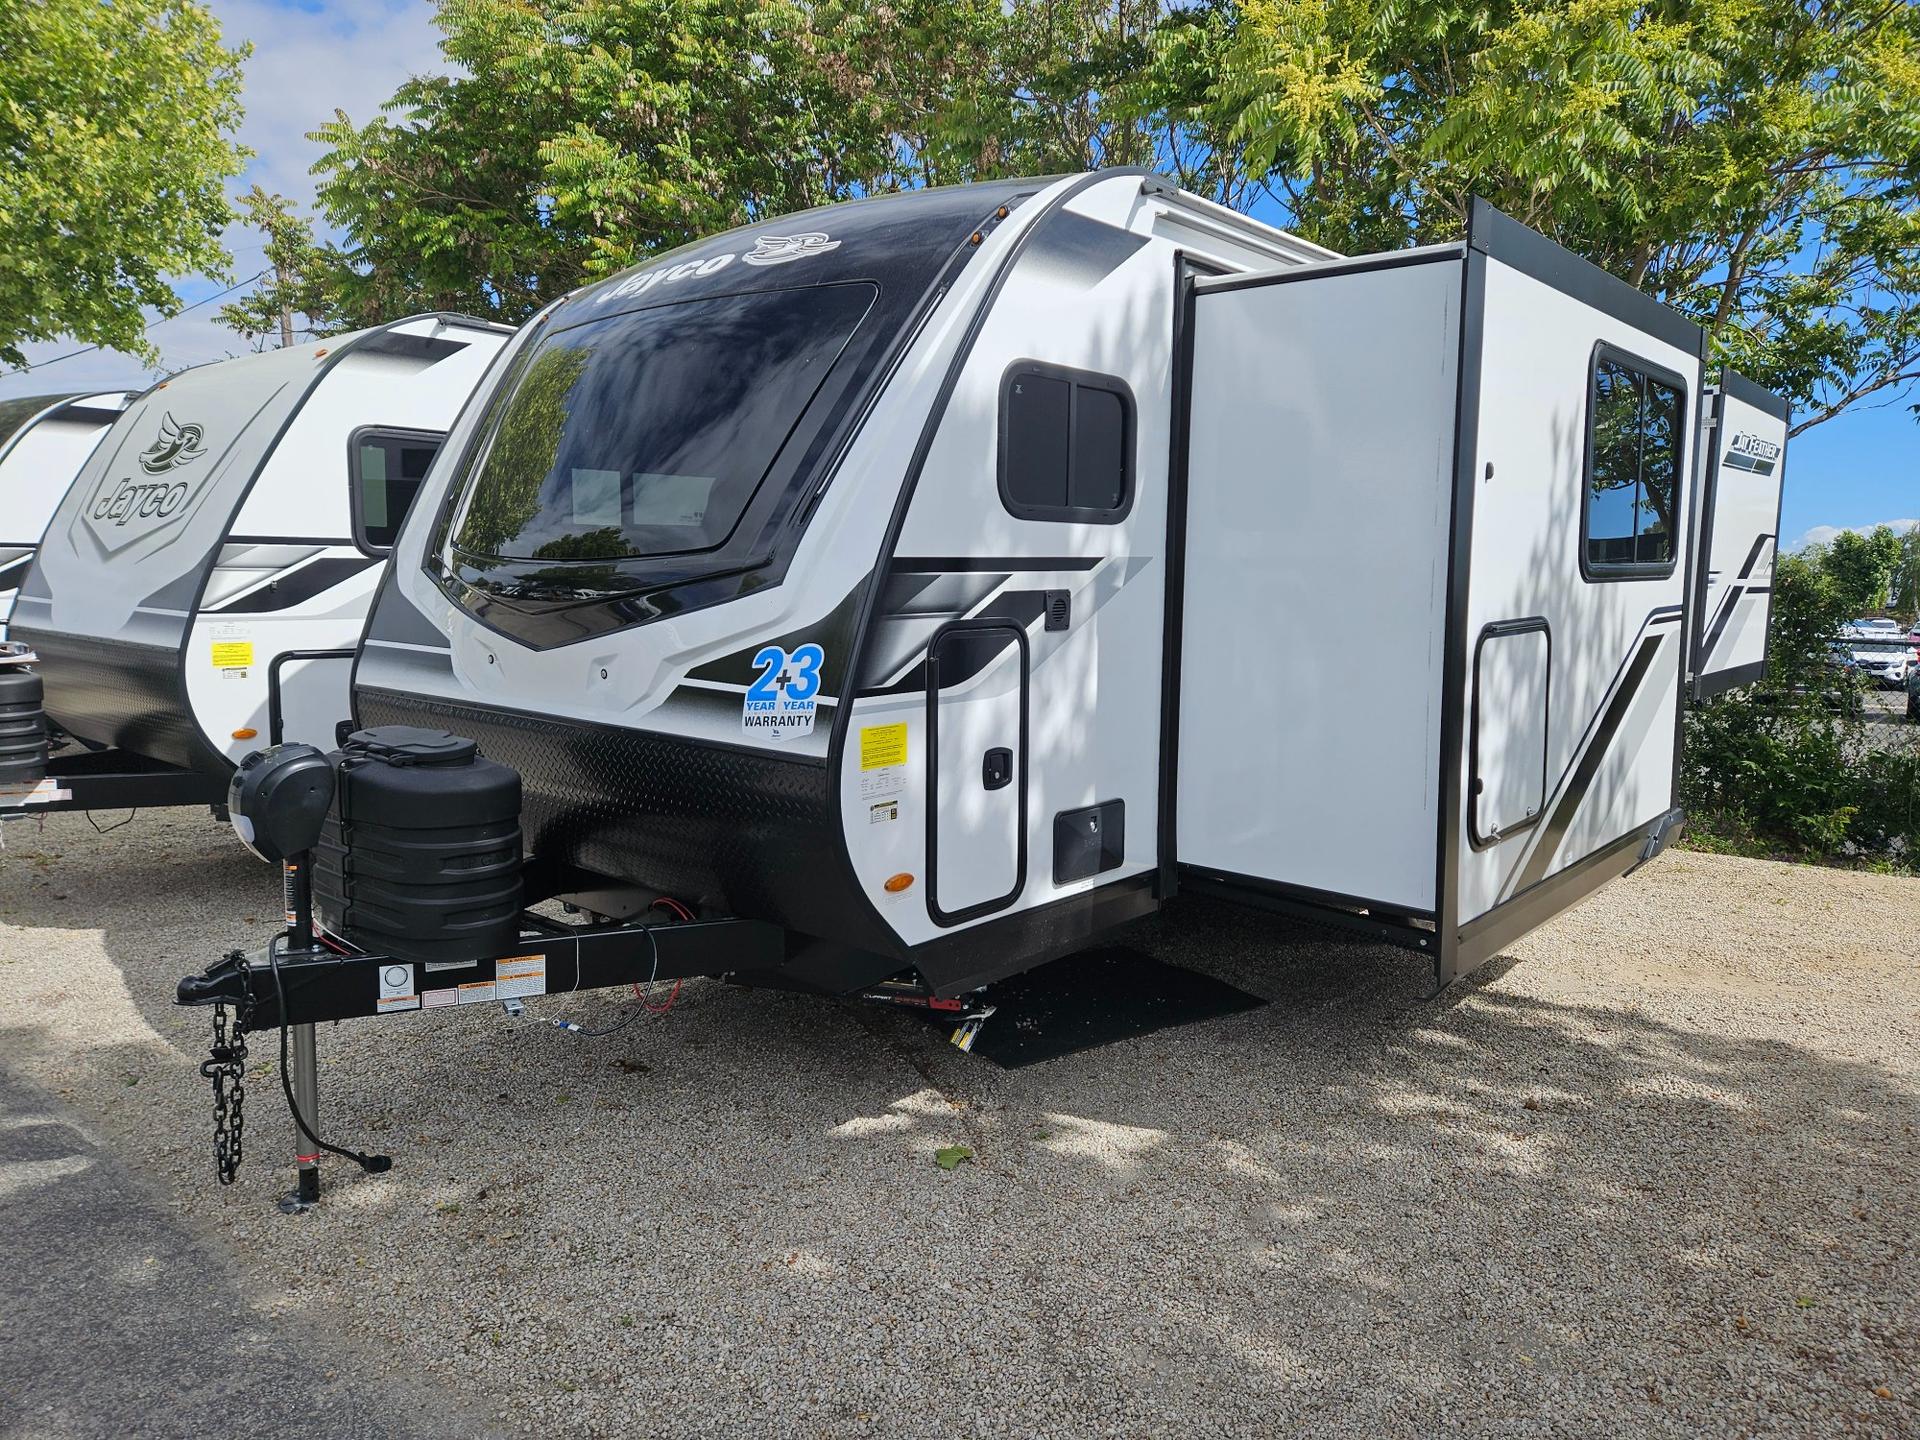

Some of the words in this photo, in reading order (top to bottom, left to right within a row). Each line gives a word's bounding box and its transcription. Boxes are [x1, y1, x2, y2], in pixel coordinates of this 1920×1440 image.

[595, 253, 736, 304] Jayco
[94, 478, 188, 526] Jayco
[744, 715, 812, 727] WARRANTY
[746, 702, 776, 711] YEAR
[783, 701, 815, 710] YEAR
